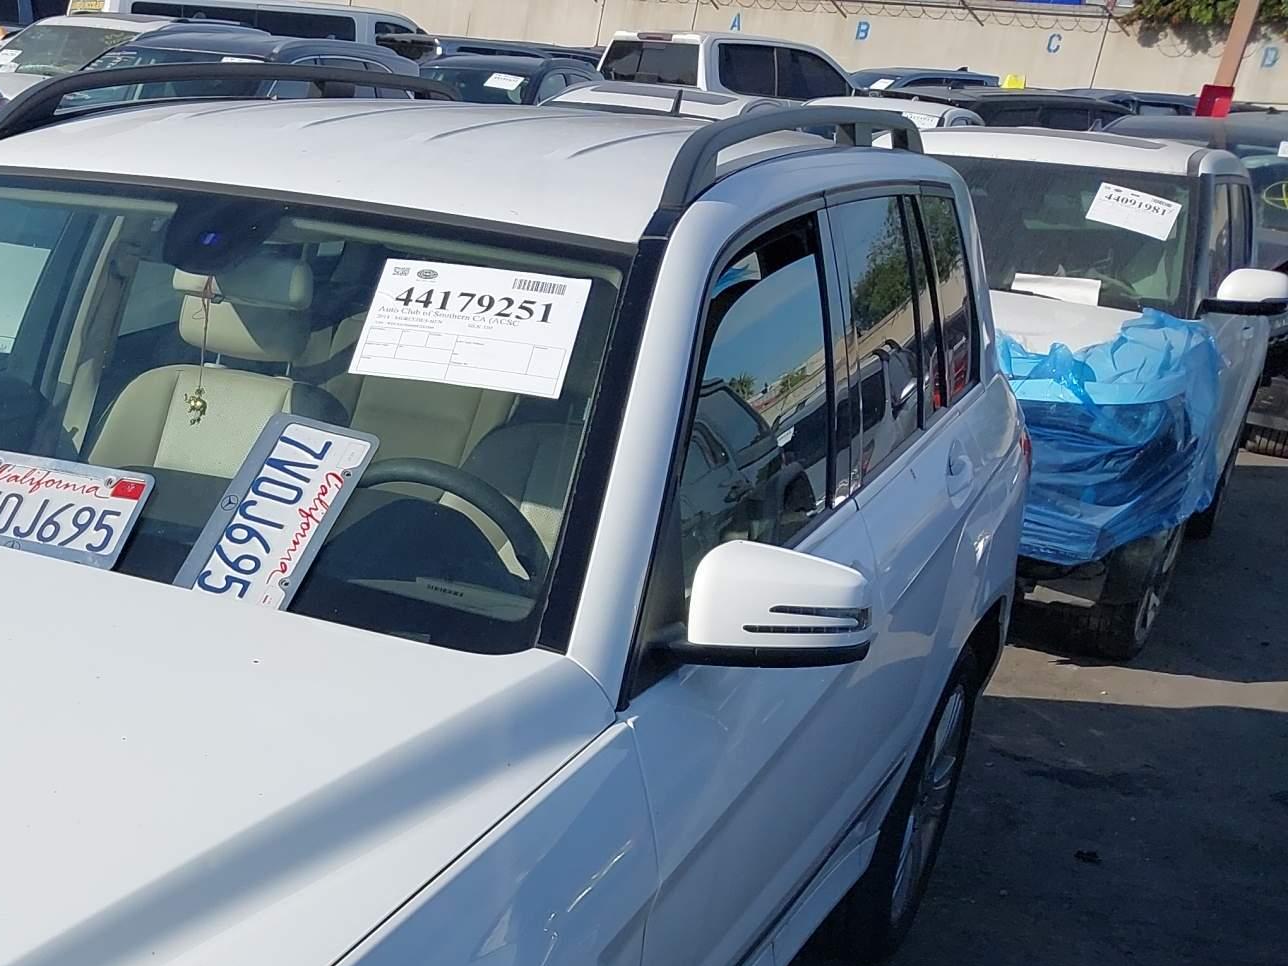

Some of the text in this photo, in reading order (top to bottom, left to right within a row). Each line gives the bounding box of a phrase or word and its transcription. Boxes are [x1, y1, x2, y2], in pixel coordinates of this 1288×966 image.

[729, 13, 742, 32] A
[854, 21, 871, 42] B
[1046, 33, 1063, 54] C
[1260, 46, 1279, 69] D
[1104, 192, 1167, 216] 44091981
[378, 305, 399, 314] Auto
[401, 307, 421, 316] Club
[423, 310, 432, 318] of
[434, 311, 470, 322] Southern
[472, 315, 487, 323] CA
[395, 286, 554, 323] 44179251
[265, 471, 345, 584] California
